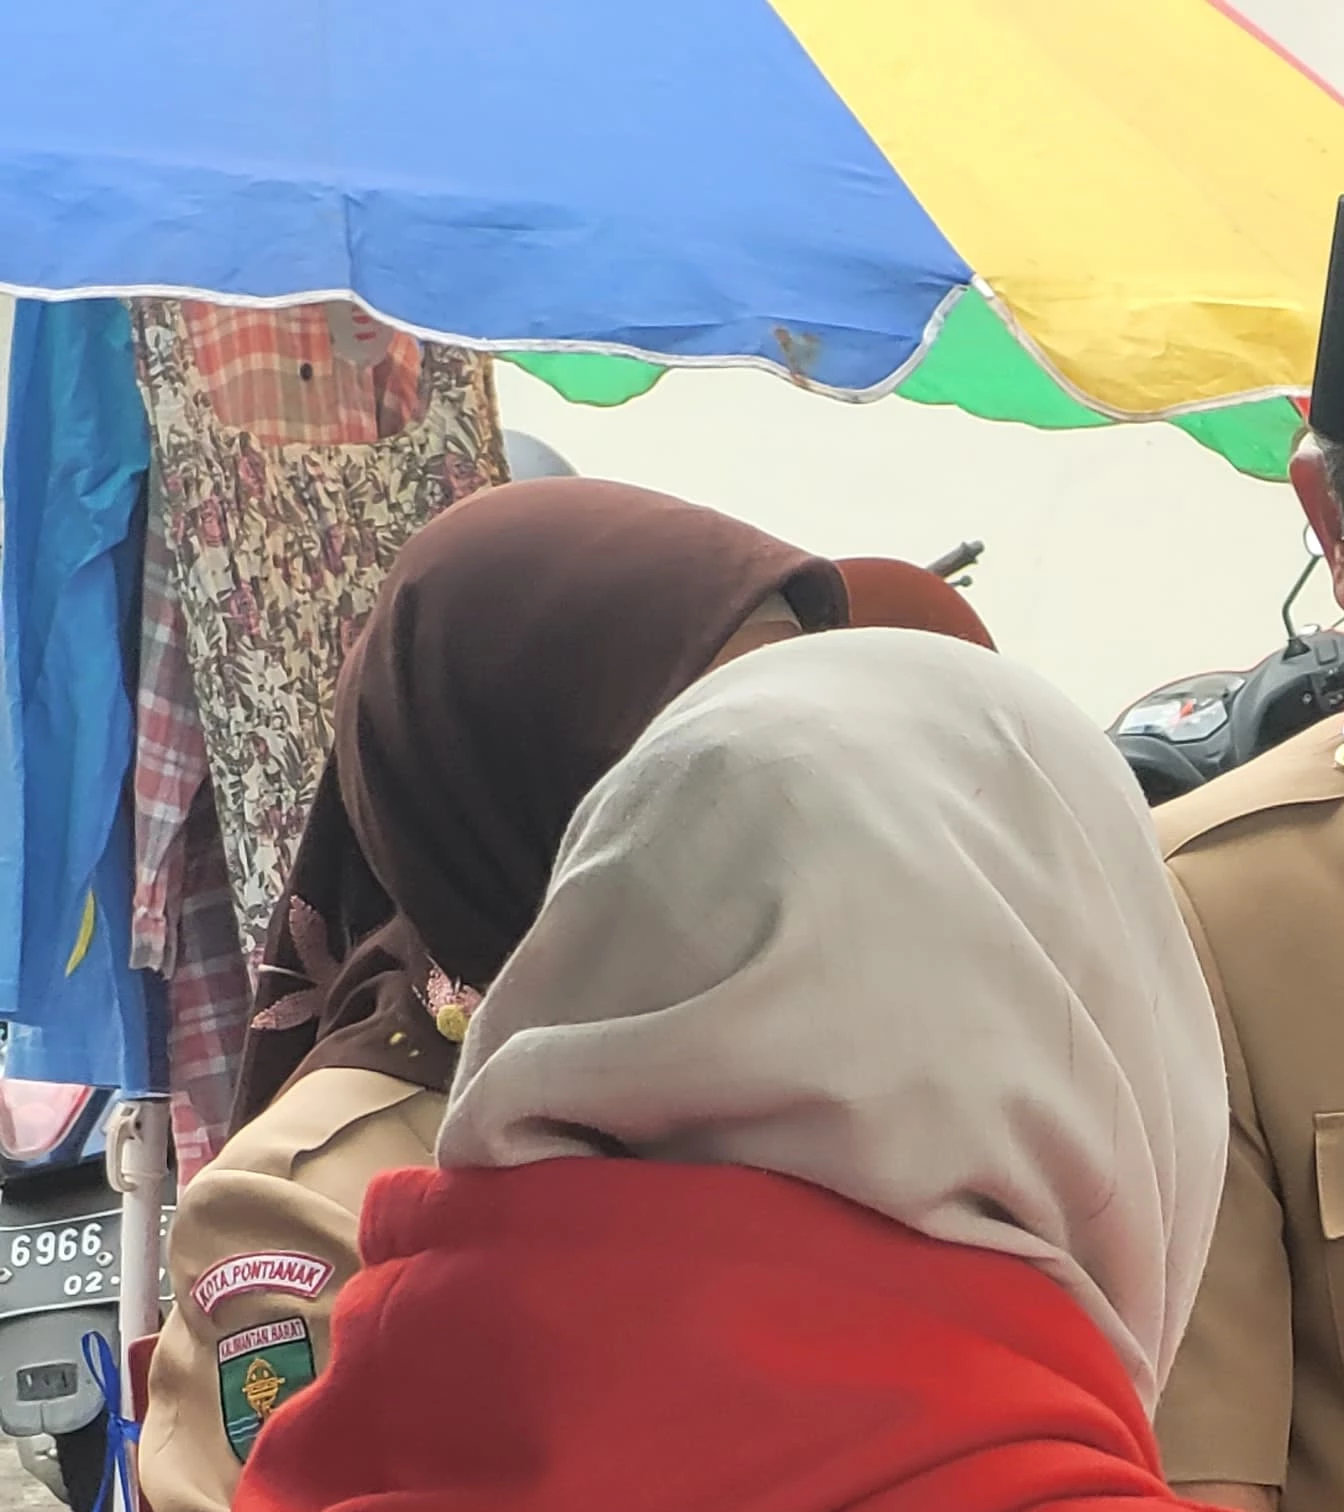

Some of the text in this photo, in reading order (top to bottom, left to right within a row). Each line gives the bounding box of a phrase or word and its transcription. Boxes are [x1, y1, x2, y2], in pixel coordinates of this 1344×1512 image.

[11, 1222, 102, 1267] 6966
[200, 1260, 320, 1306] KOTA PONTIANAK
